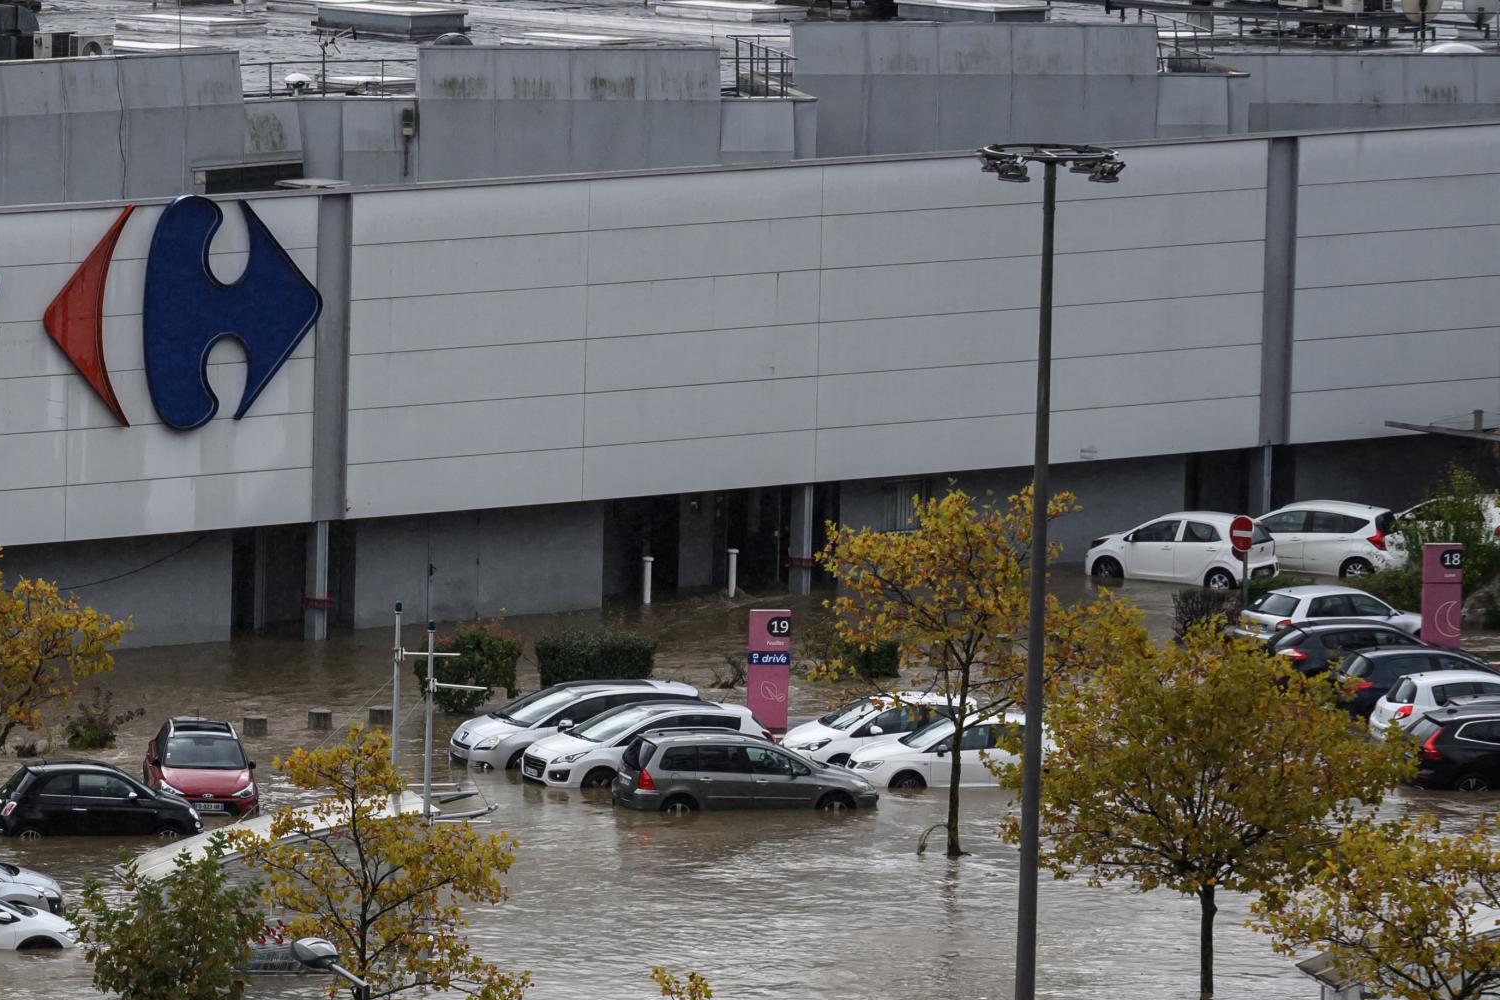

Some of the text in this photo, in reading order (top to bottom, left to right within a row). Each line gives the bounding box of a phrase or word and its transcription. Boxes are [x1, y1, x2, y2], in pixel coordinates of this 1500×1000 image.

[1443, 553, 1461, 566] 18
[771, 620, 789, 633] 19
[761, 653, 787, 663] drive
